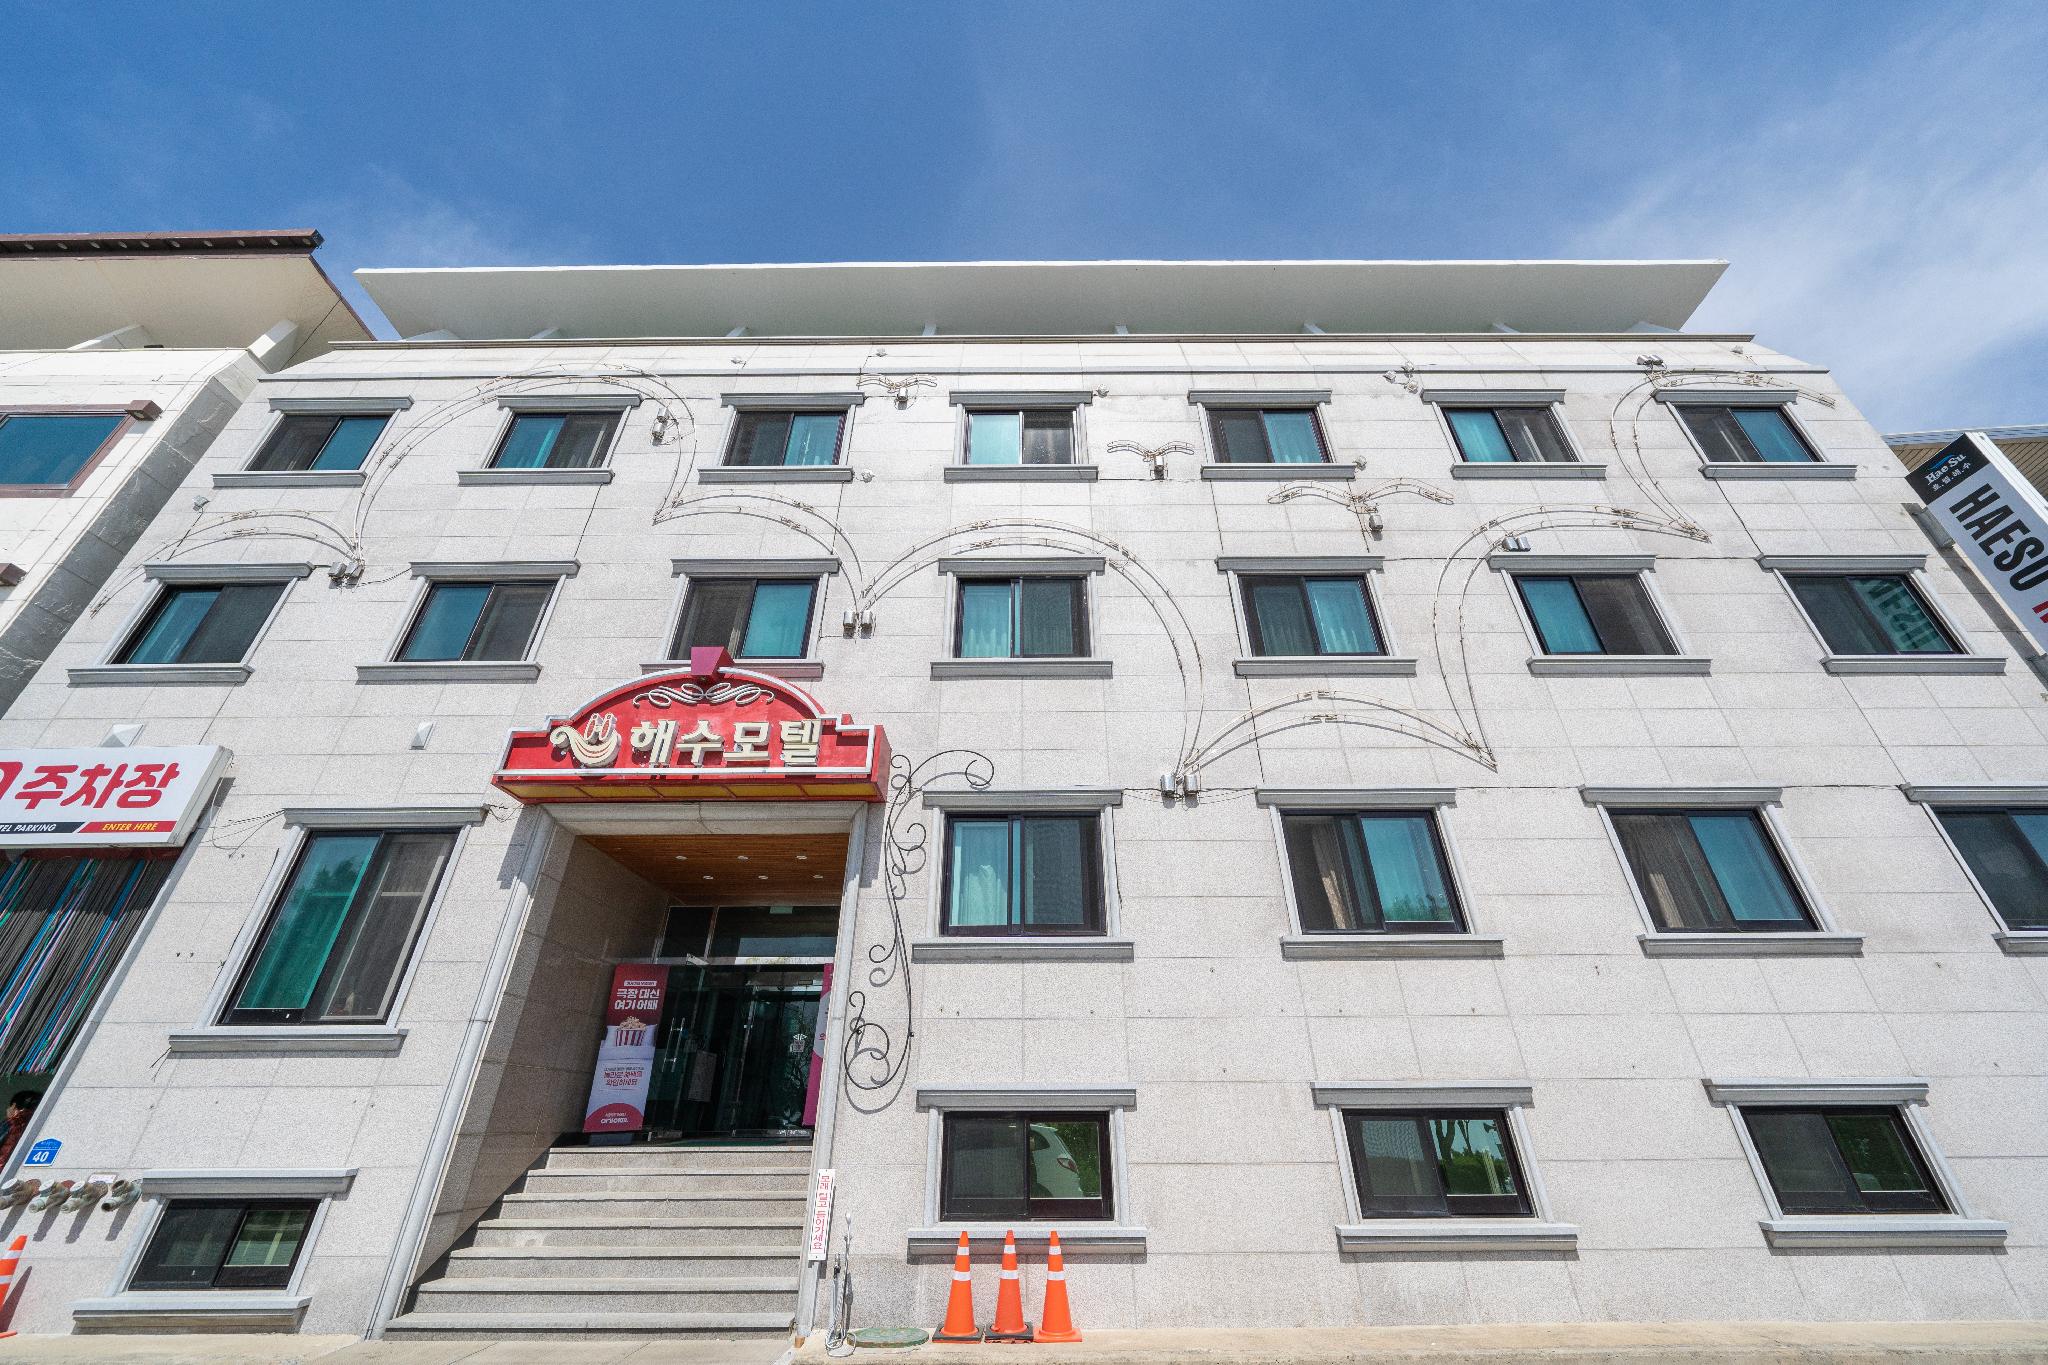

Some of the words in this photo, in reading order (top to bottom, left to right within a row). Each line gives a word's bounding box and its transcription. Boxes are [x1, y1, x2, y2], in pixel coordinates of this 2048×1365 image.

[1949, 483, 2048, 592] HAESU
[631, 719, 822, 768] 해수모텔
[15, 762, 180, 810] 주차장
[14, 823, 57, 832] PARKING
[101, 823, 132, 831] ENTER
[132, 822, 158, 831] HERE
[33, 1151, 49, 1162] 40
